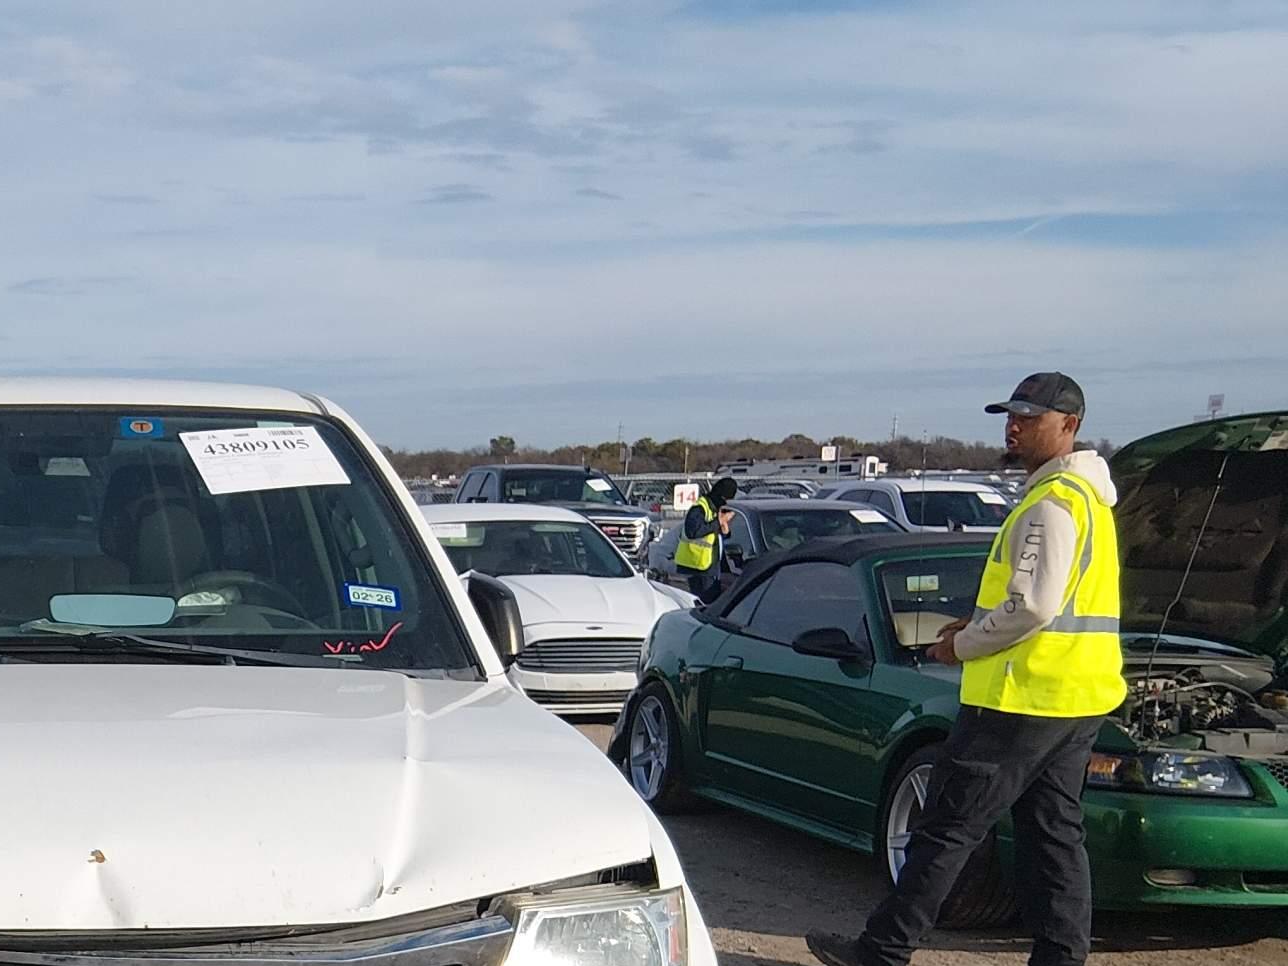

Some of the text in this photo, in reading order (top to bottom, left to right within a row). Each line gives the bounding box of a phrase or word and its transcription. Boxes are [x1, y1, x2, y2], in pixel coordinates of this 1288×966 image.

[204, 438, 310, 456] 43809105
[677, 490, 697, 504] 14
[1017, 521, 1045, 576] JUST
